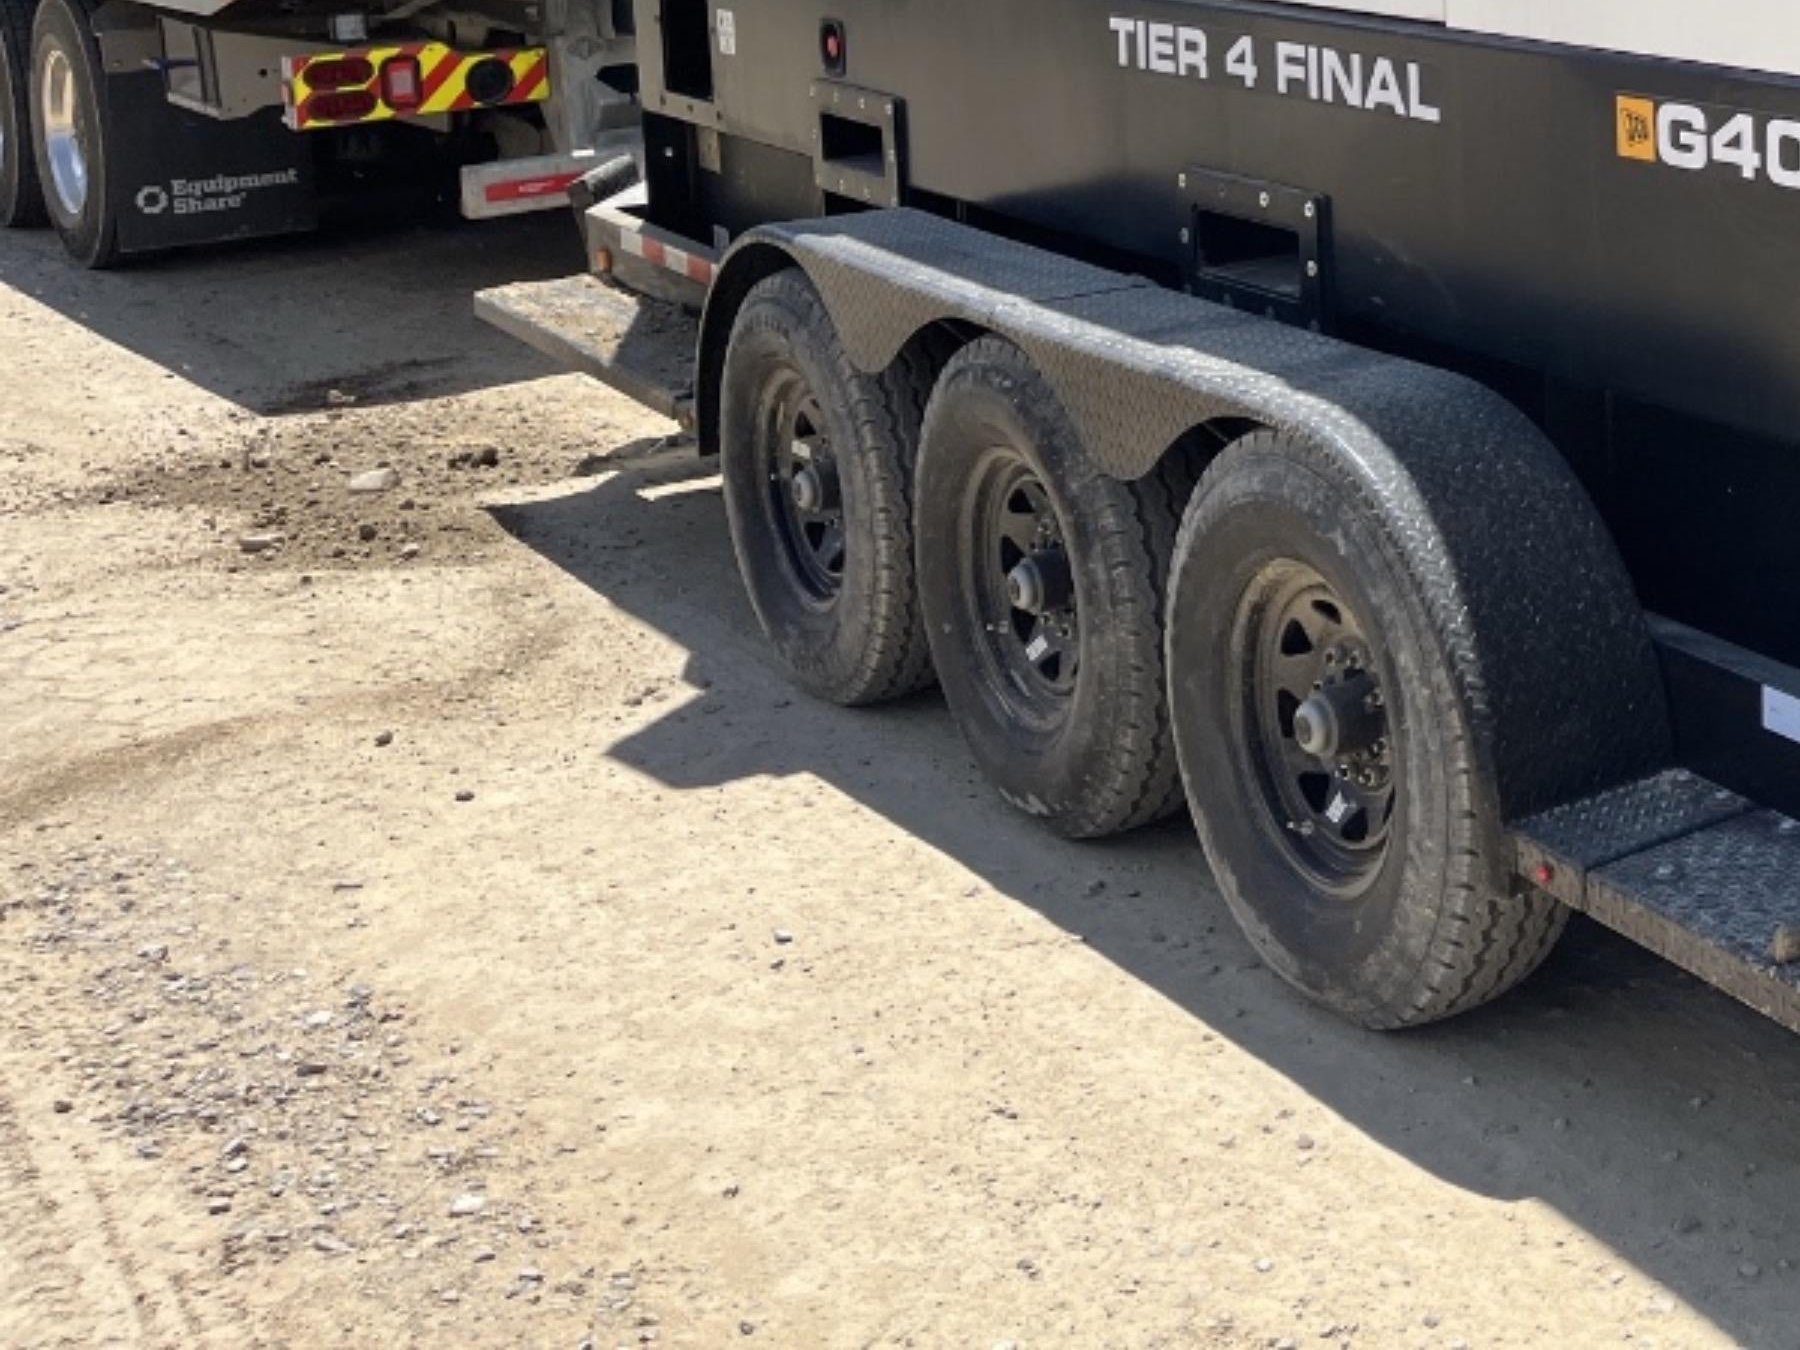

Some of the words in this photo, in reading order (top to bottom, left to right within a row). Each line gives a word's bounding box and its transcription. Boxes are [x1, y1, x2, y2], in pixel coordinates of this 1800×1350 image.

[1109, 16, 1208, 79] TIER
[1225, 35, 1258, 89] 4
[1276, 41, 1441, 123] FINAL
[170, 167, 298, 197] Equipment
[172, 193, 242, 214] Share
